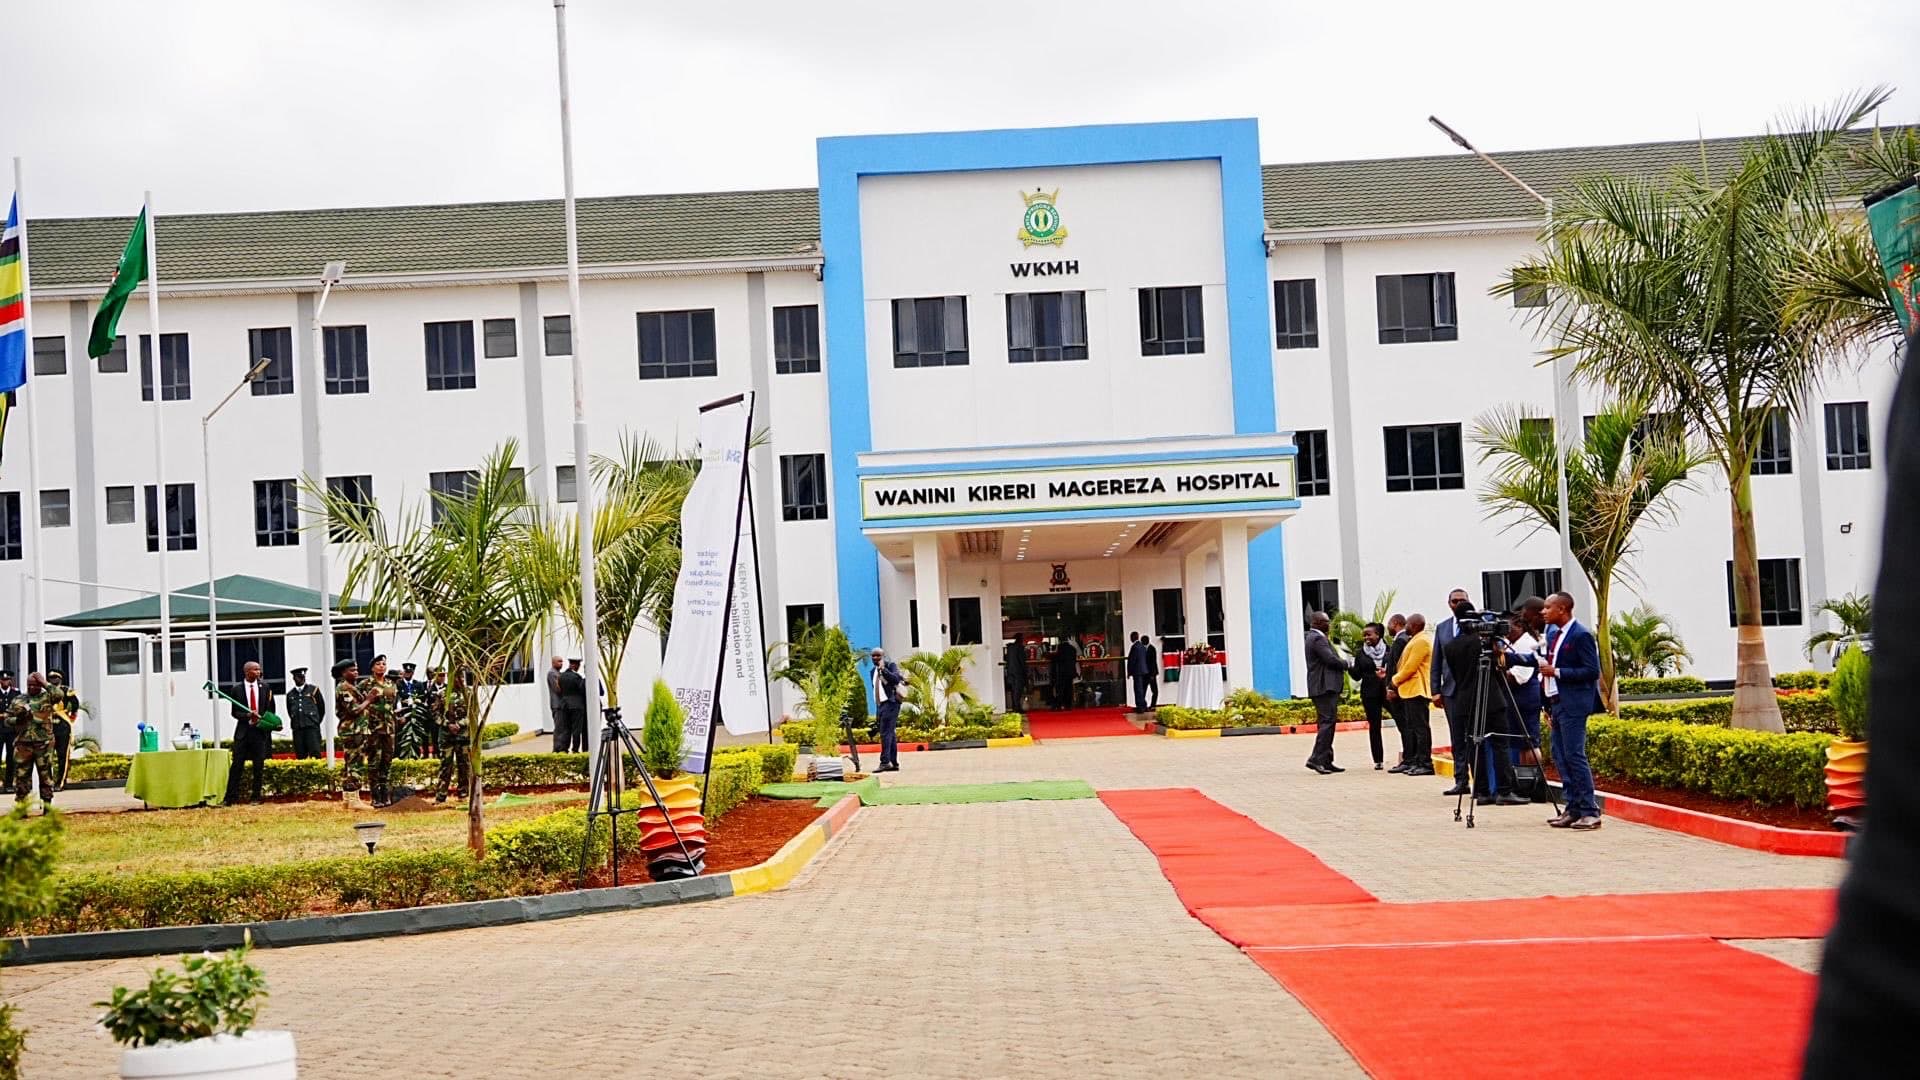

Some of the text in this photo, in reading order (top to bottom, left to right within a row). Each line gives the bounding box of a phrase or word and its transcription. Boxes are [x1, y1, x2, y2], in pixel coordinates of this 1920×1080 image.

[1010, 260, 1079, 277] WKMH
[875, 471, 1280, 506] WANINI KIRERI MAGEREZA HOSPITAL
[737, 562, 757, 697] KENYA PRISONS SERVICE
[735, 658, 744, 679] and
